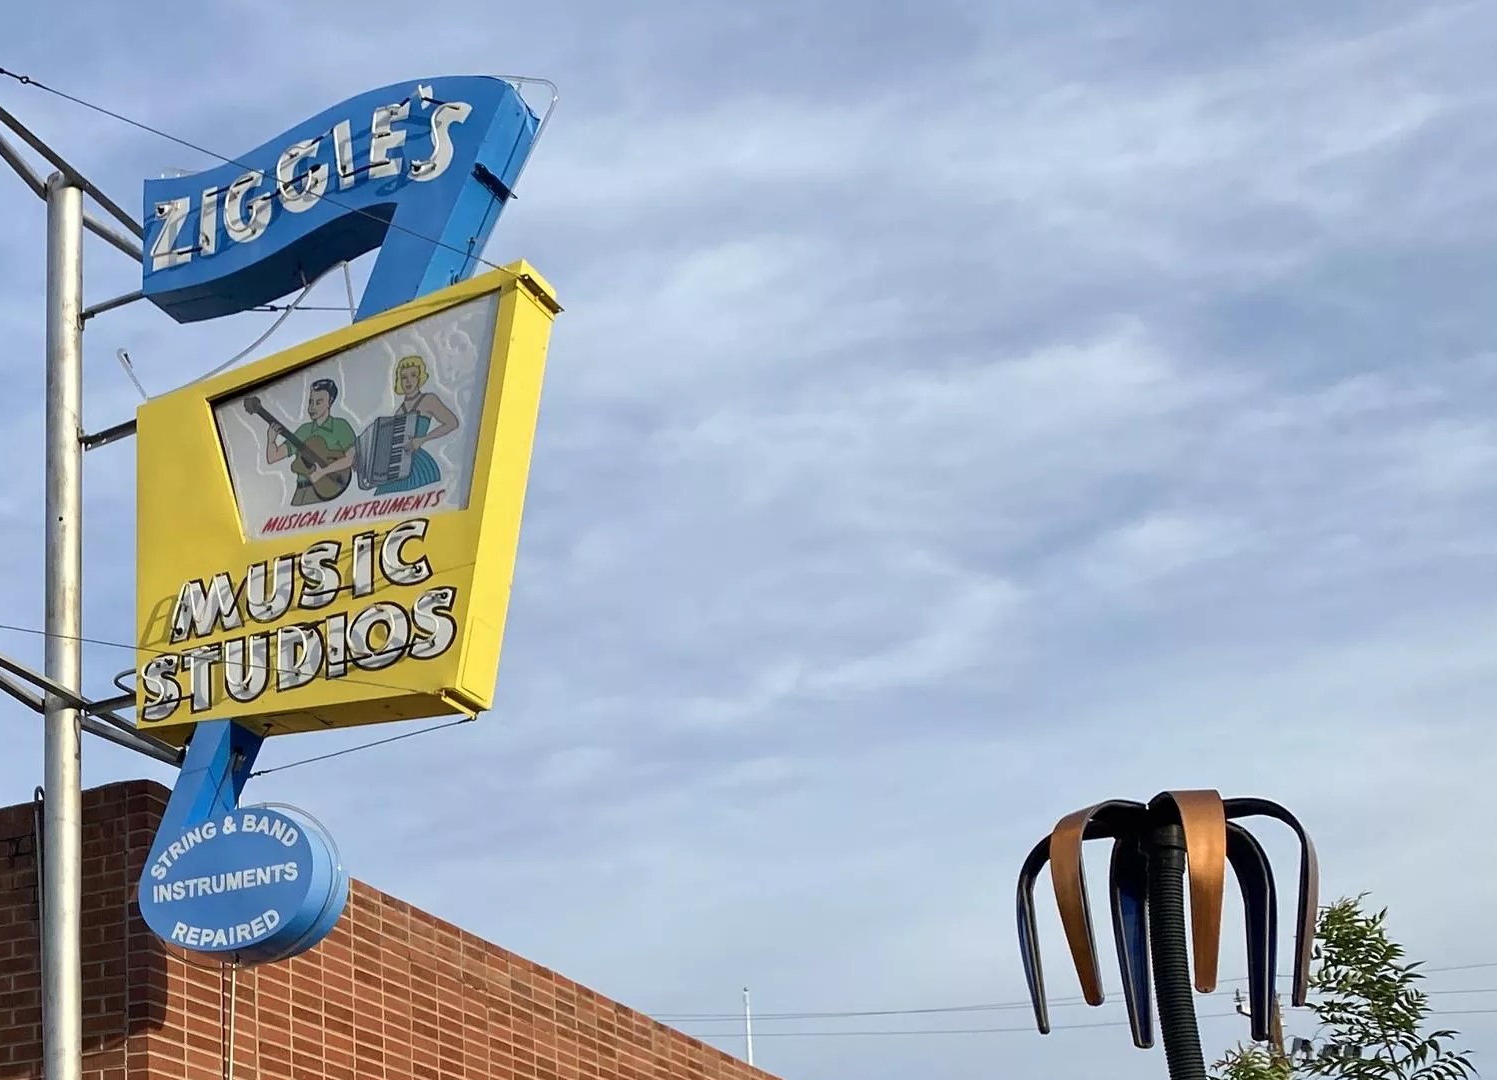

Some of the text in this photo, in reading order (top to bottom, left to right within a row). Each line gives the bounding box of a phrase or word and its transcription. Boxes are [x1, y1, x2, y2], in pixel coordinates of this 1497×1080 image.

[150, 84, 472, 271] ZIGGIE'S
[262, 490, 445, 534] MUSICAL INSTRUMENTS
[170, 518, 432, 644] MUSIC
[141, 587, 457, 721] STUDIOS
[151, 814, 299, 880] STRING & BAND
[153, 862, 298, 904] INSTRUMENTS
[171, 908, 280, 947] REPAIRED
